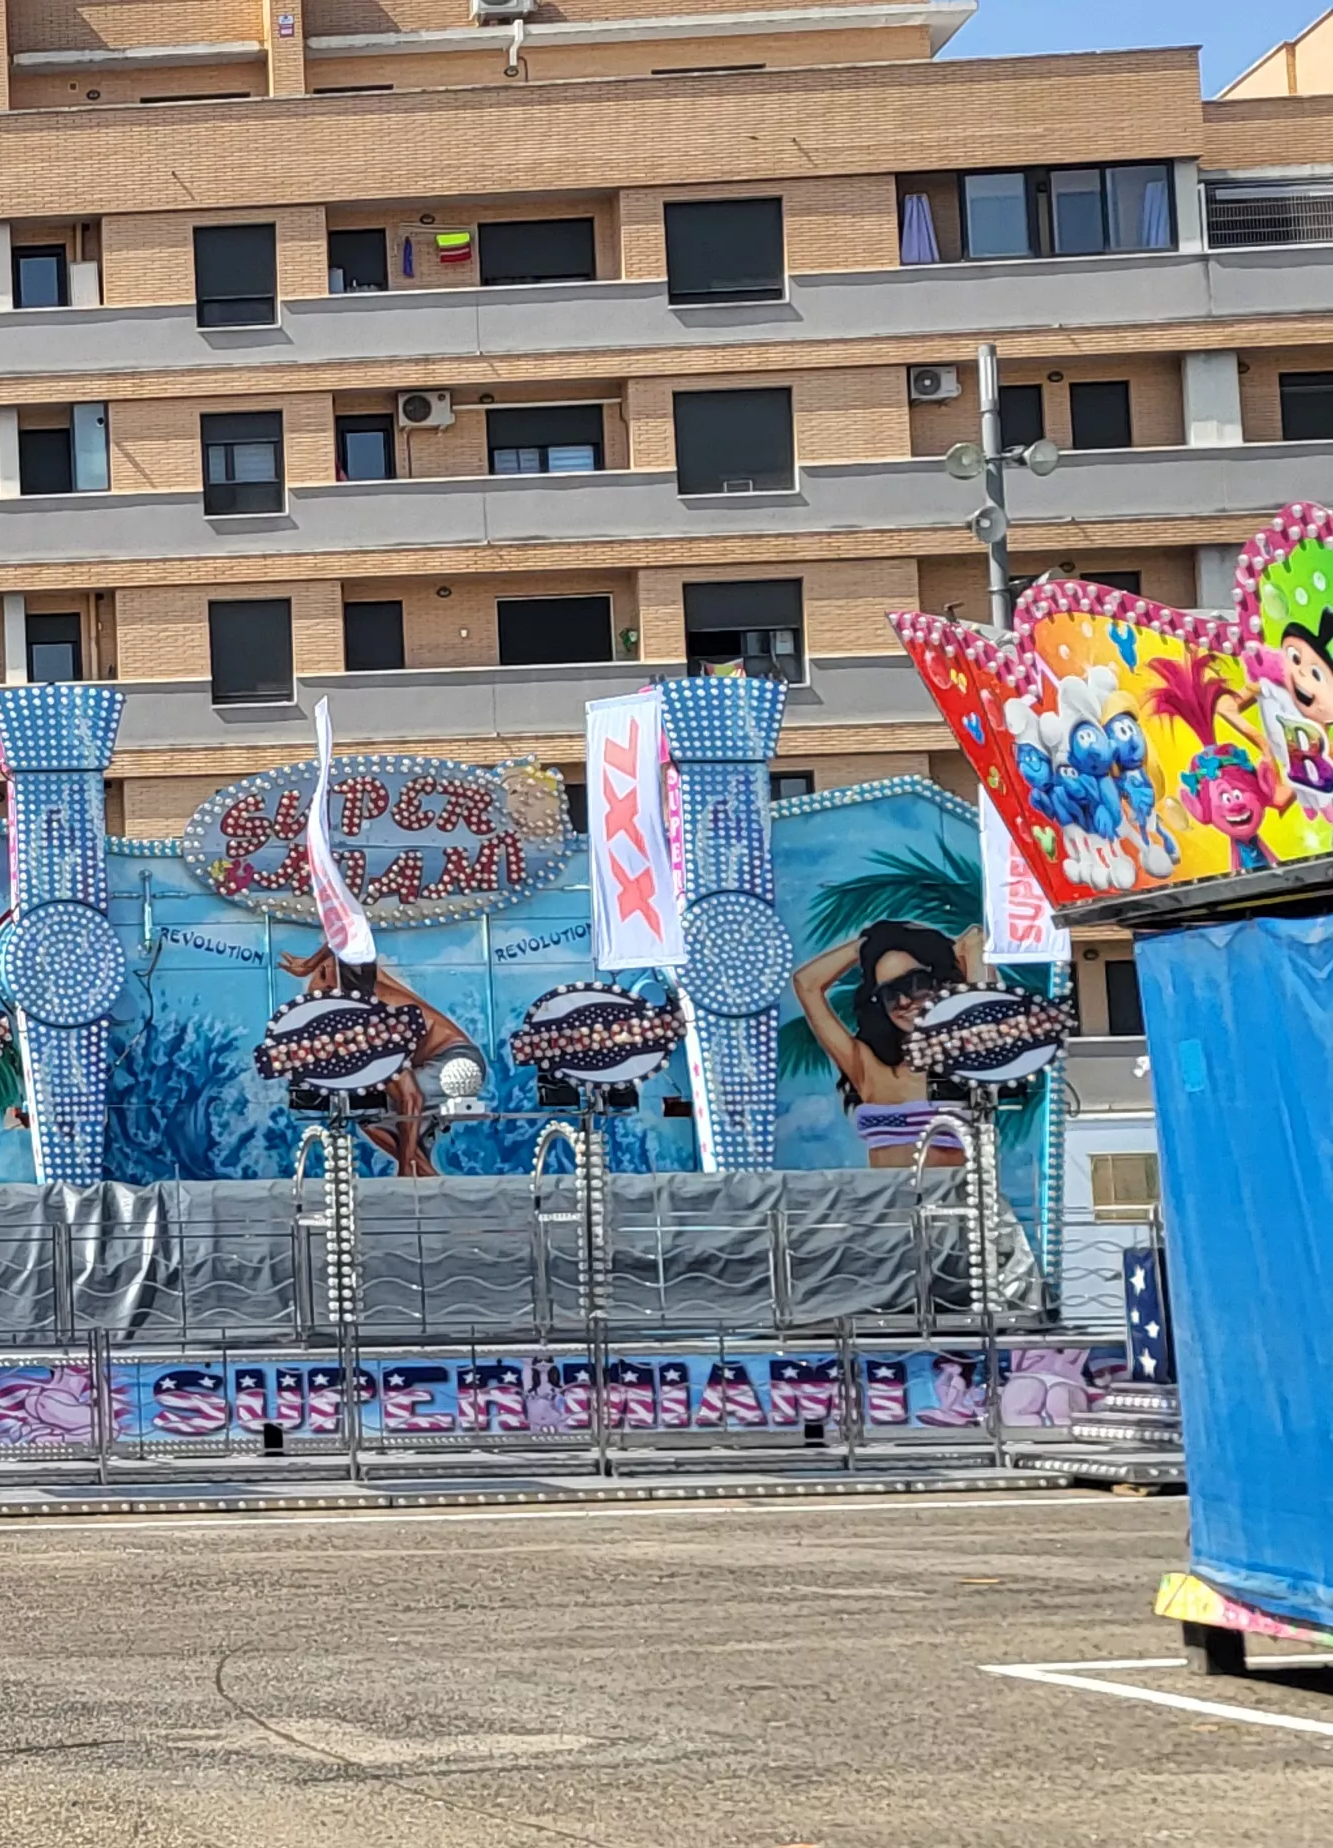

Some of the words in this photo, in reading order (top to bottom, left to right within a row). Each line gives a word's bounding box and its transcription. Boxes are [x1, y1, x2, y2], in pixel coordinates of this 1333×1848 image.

[219, 775, 498, 858] SUPER
[603, 715, 664, 945] XXL
[667, 766, 685, 901] SUPER
[160, 926, 265, 966] REVOLUTION
[152, 1365, 530, 1436] SUPER
[562, 1360, 910, 1428] MIAMI
